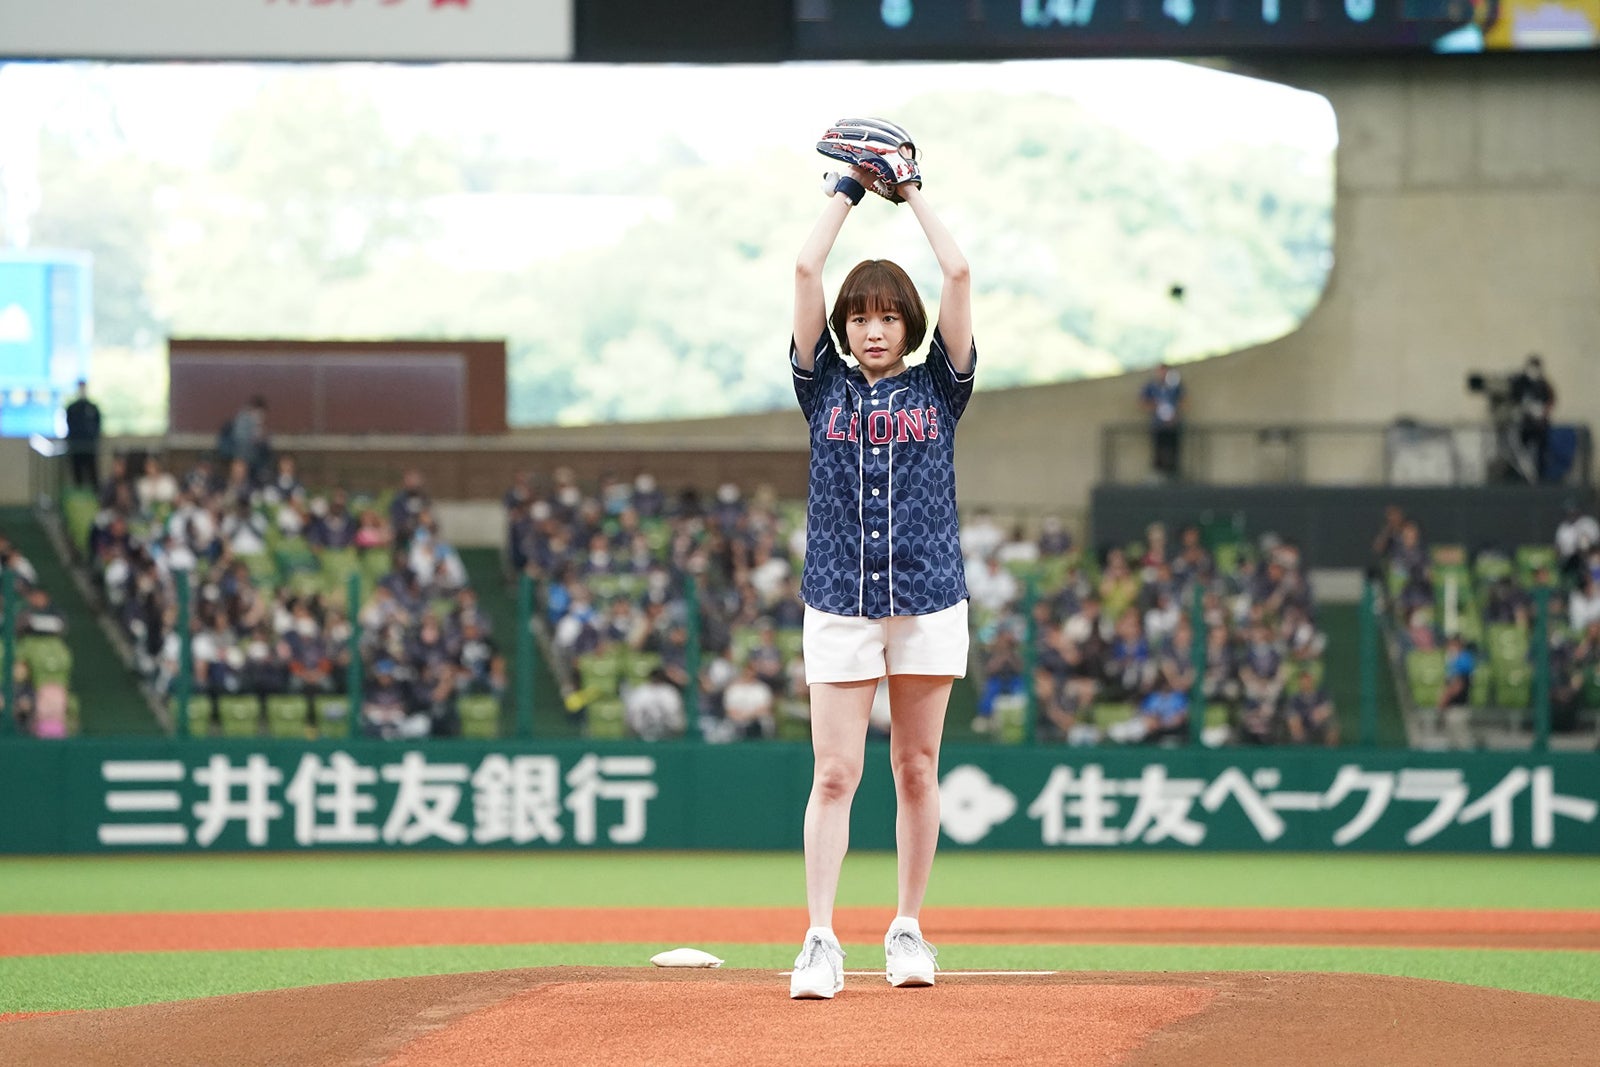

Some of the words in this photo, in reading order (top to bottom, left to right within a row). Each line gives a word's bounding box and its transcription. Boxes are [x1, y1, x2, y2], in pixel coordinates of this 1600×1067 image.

[826, 405, 939, 445] LIONS
[98, 752, 658, 847] 三井住友銀行
[1027, 764, 1599, 848] 住友ベークライト
